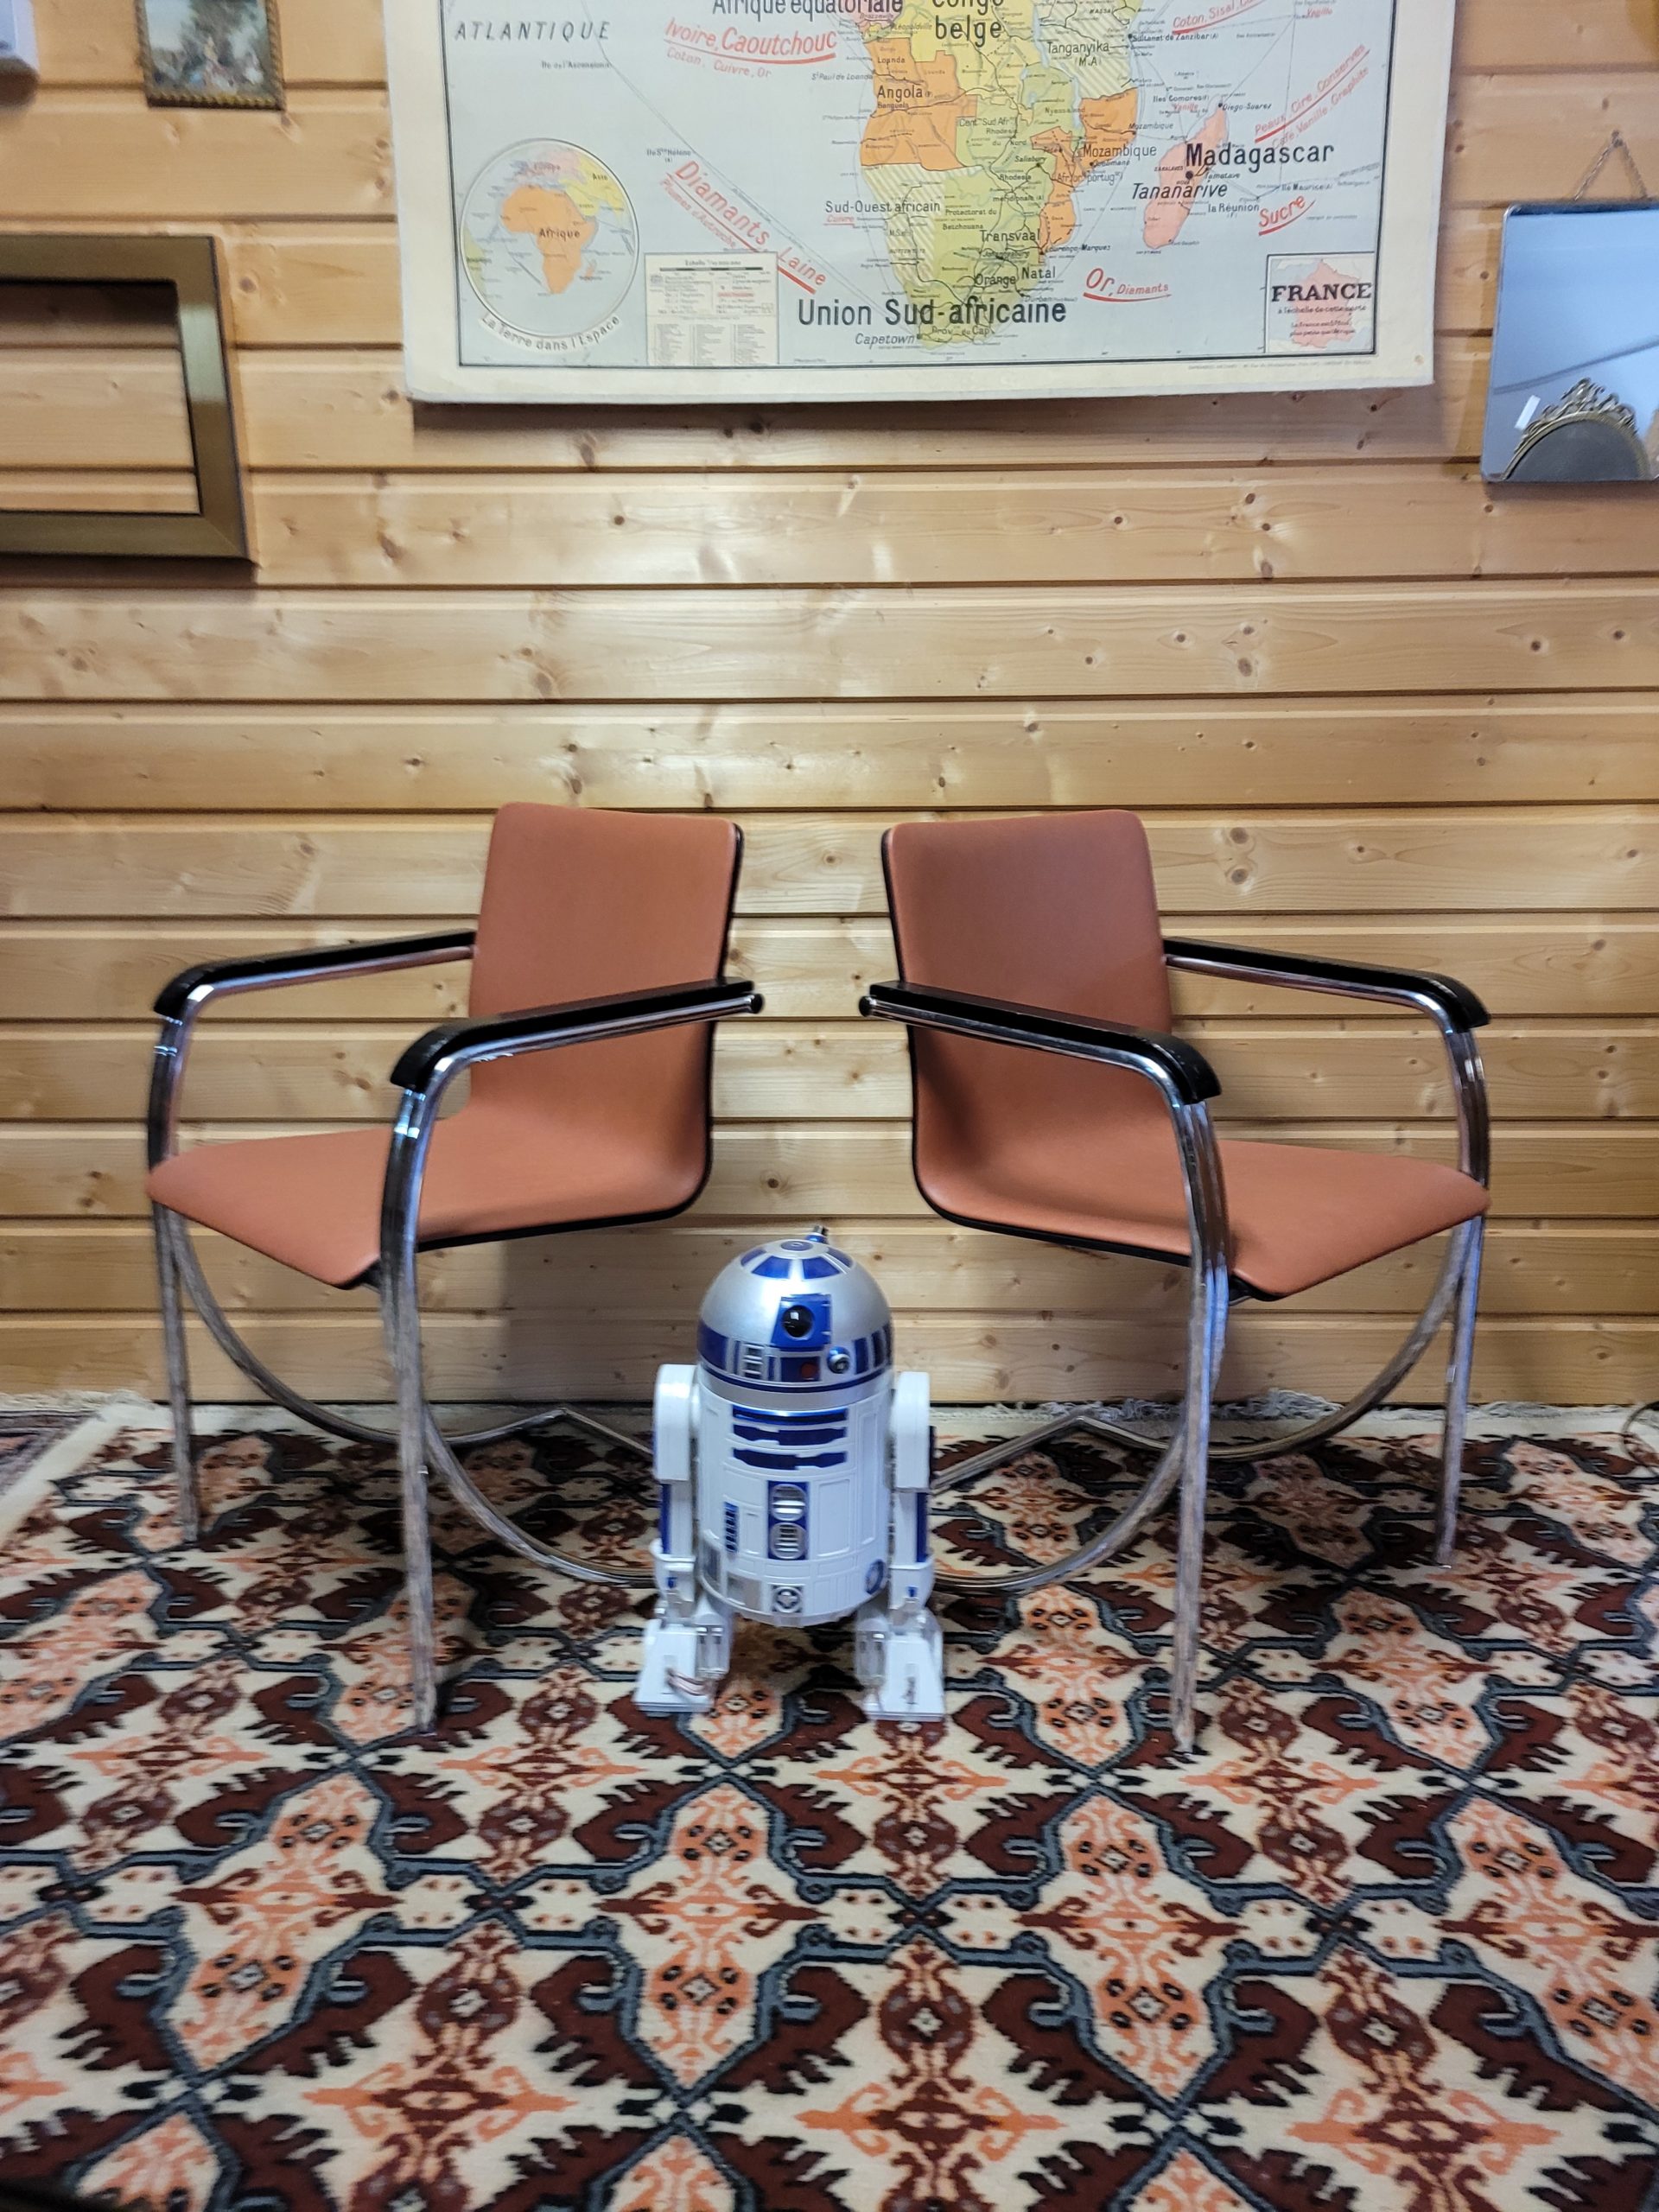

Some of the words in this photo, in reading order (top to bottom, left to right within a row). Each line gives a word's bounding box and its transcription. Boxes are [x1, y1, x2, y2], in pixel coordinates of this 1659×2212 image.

[454, 21, 611, 42] ATLANTIQUE
[935, 15, 1002, 48] belge
[721, 27, 837, 55] Caoutchouc
[1047, 41, 1110, 57] Tanganyika
[877, 85, 924, 103] Angola
[1083, 143, 1157, 162] Mozambique
[1185, 142, 1334, 173] Madagascar
[1132, 180, 1228, 200] Tananarive
[825, 200, 892, 213] Sud-Ouest
[894, 200, 941, 213] africain
[1208, 203, 1217, 213] la
[1218, 202, 1260, 213] Réunion
[1259, 194, 1306, 228] Sucre
[538, 226, 581, 242] Afrique
[979, 228, 1040, 242] Transvaal
[778, 246, 827, 287] Laine
[1021, 265, 1056, 279] Natal
[974, 273, 1017, 289] Orange
[1116, 282, 1170, 296] Diamants
[1271, 283, 1372, 302] FRANCE
[798, 299, 872, 326] Union
[499, 322, 533, 347] Terre
[536, 338, 569, 351] dans
[972, 325, 990, 338] Cap
[855, 333, 915, 350] Capetown
